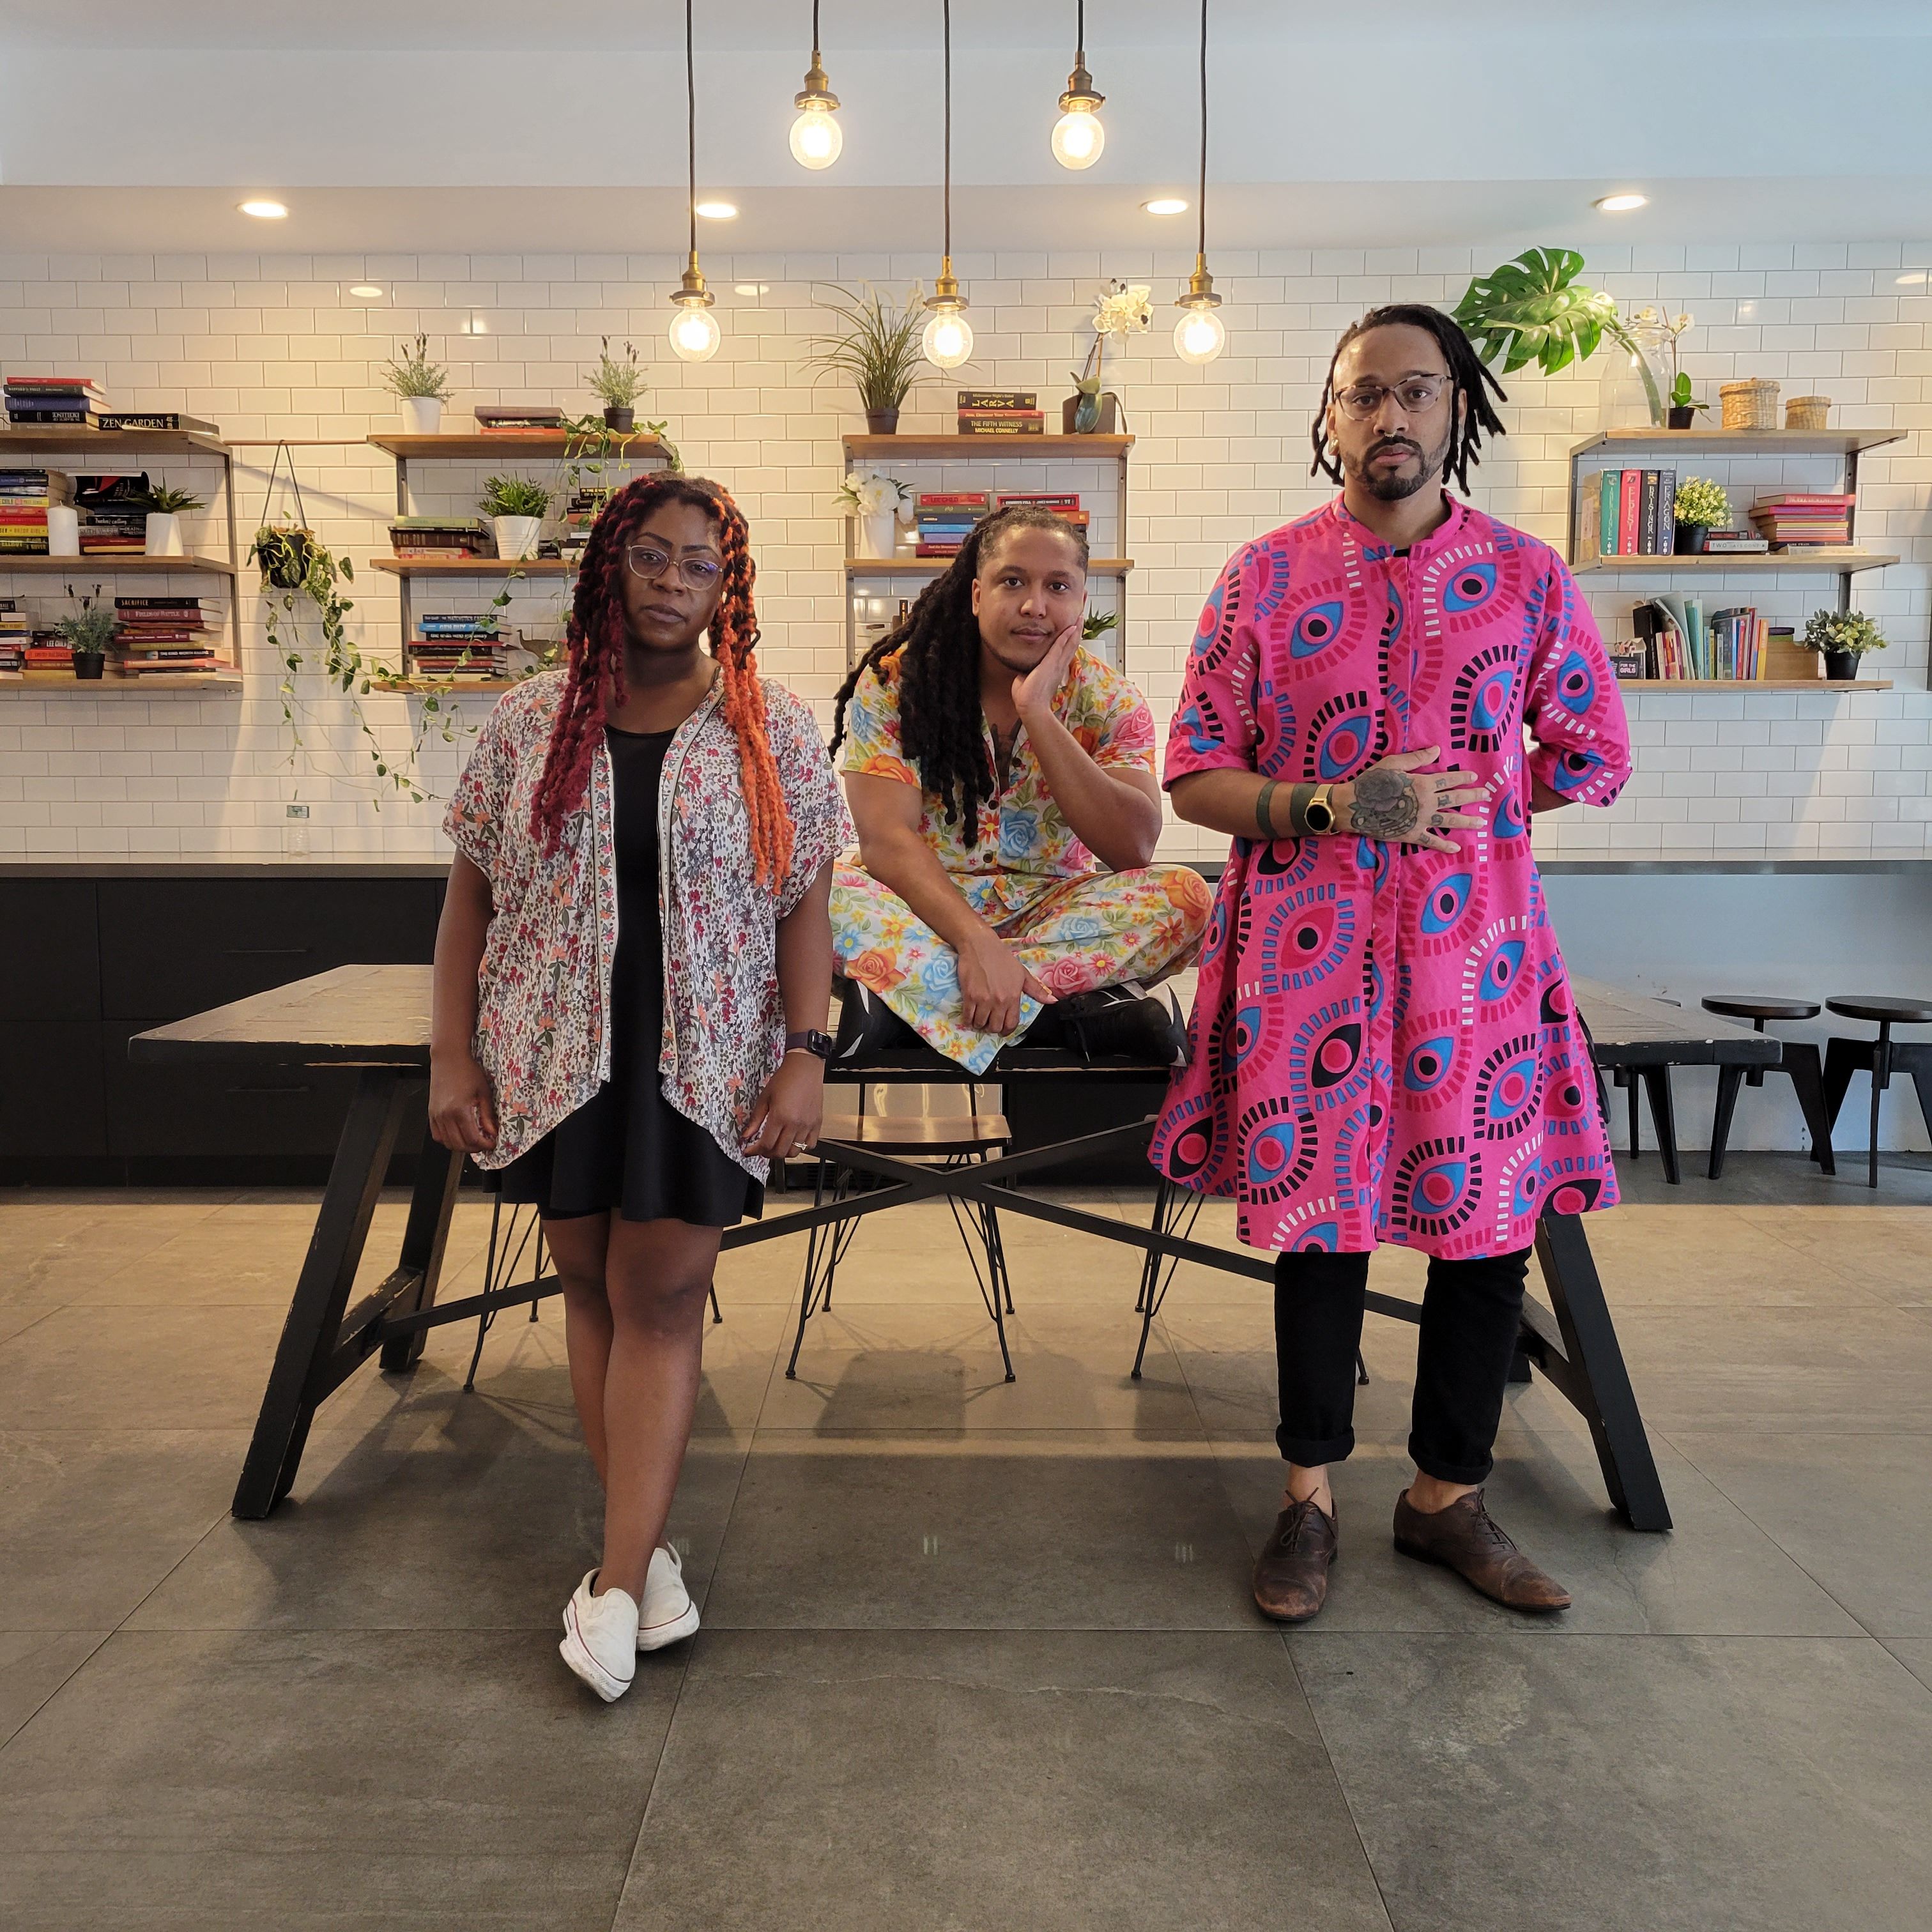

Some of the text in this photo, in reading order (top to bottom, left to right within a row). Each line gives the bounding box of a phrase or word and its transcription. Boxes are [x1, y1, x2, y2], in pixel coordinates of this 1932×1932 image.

[972, 399, 1014, 408] LARVA
[102, 418, 123, 429] ZEN
[124, 418, 164, 428] GARDEN
[1627, 486, 1636, 532] ELDEST
